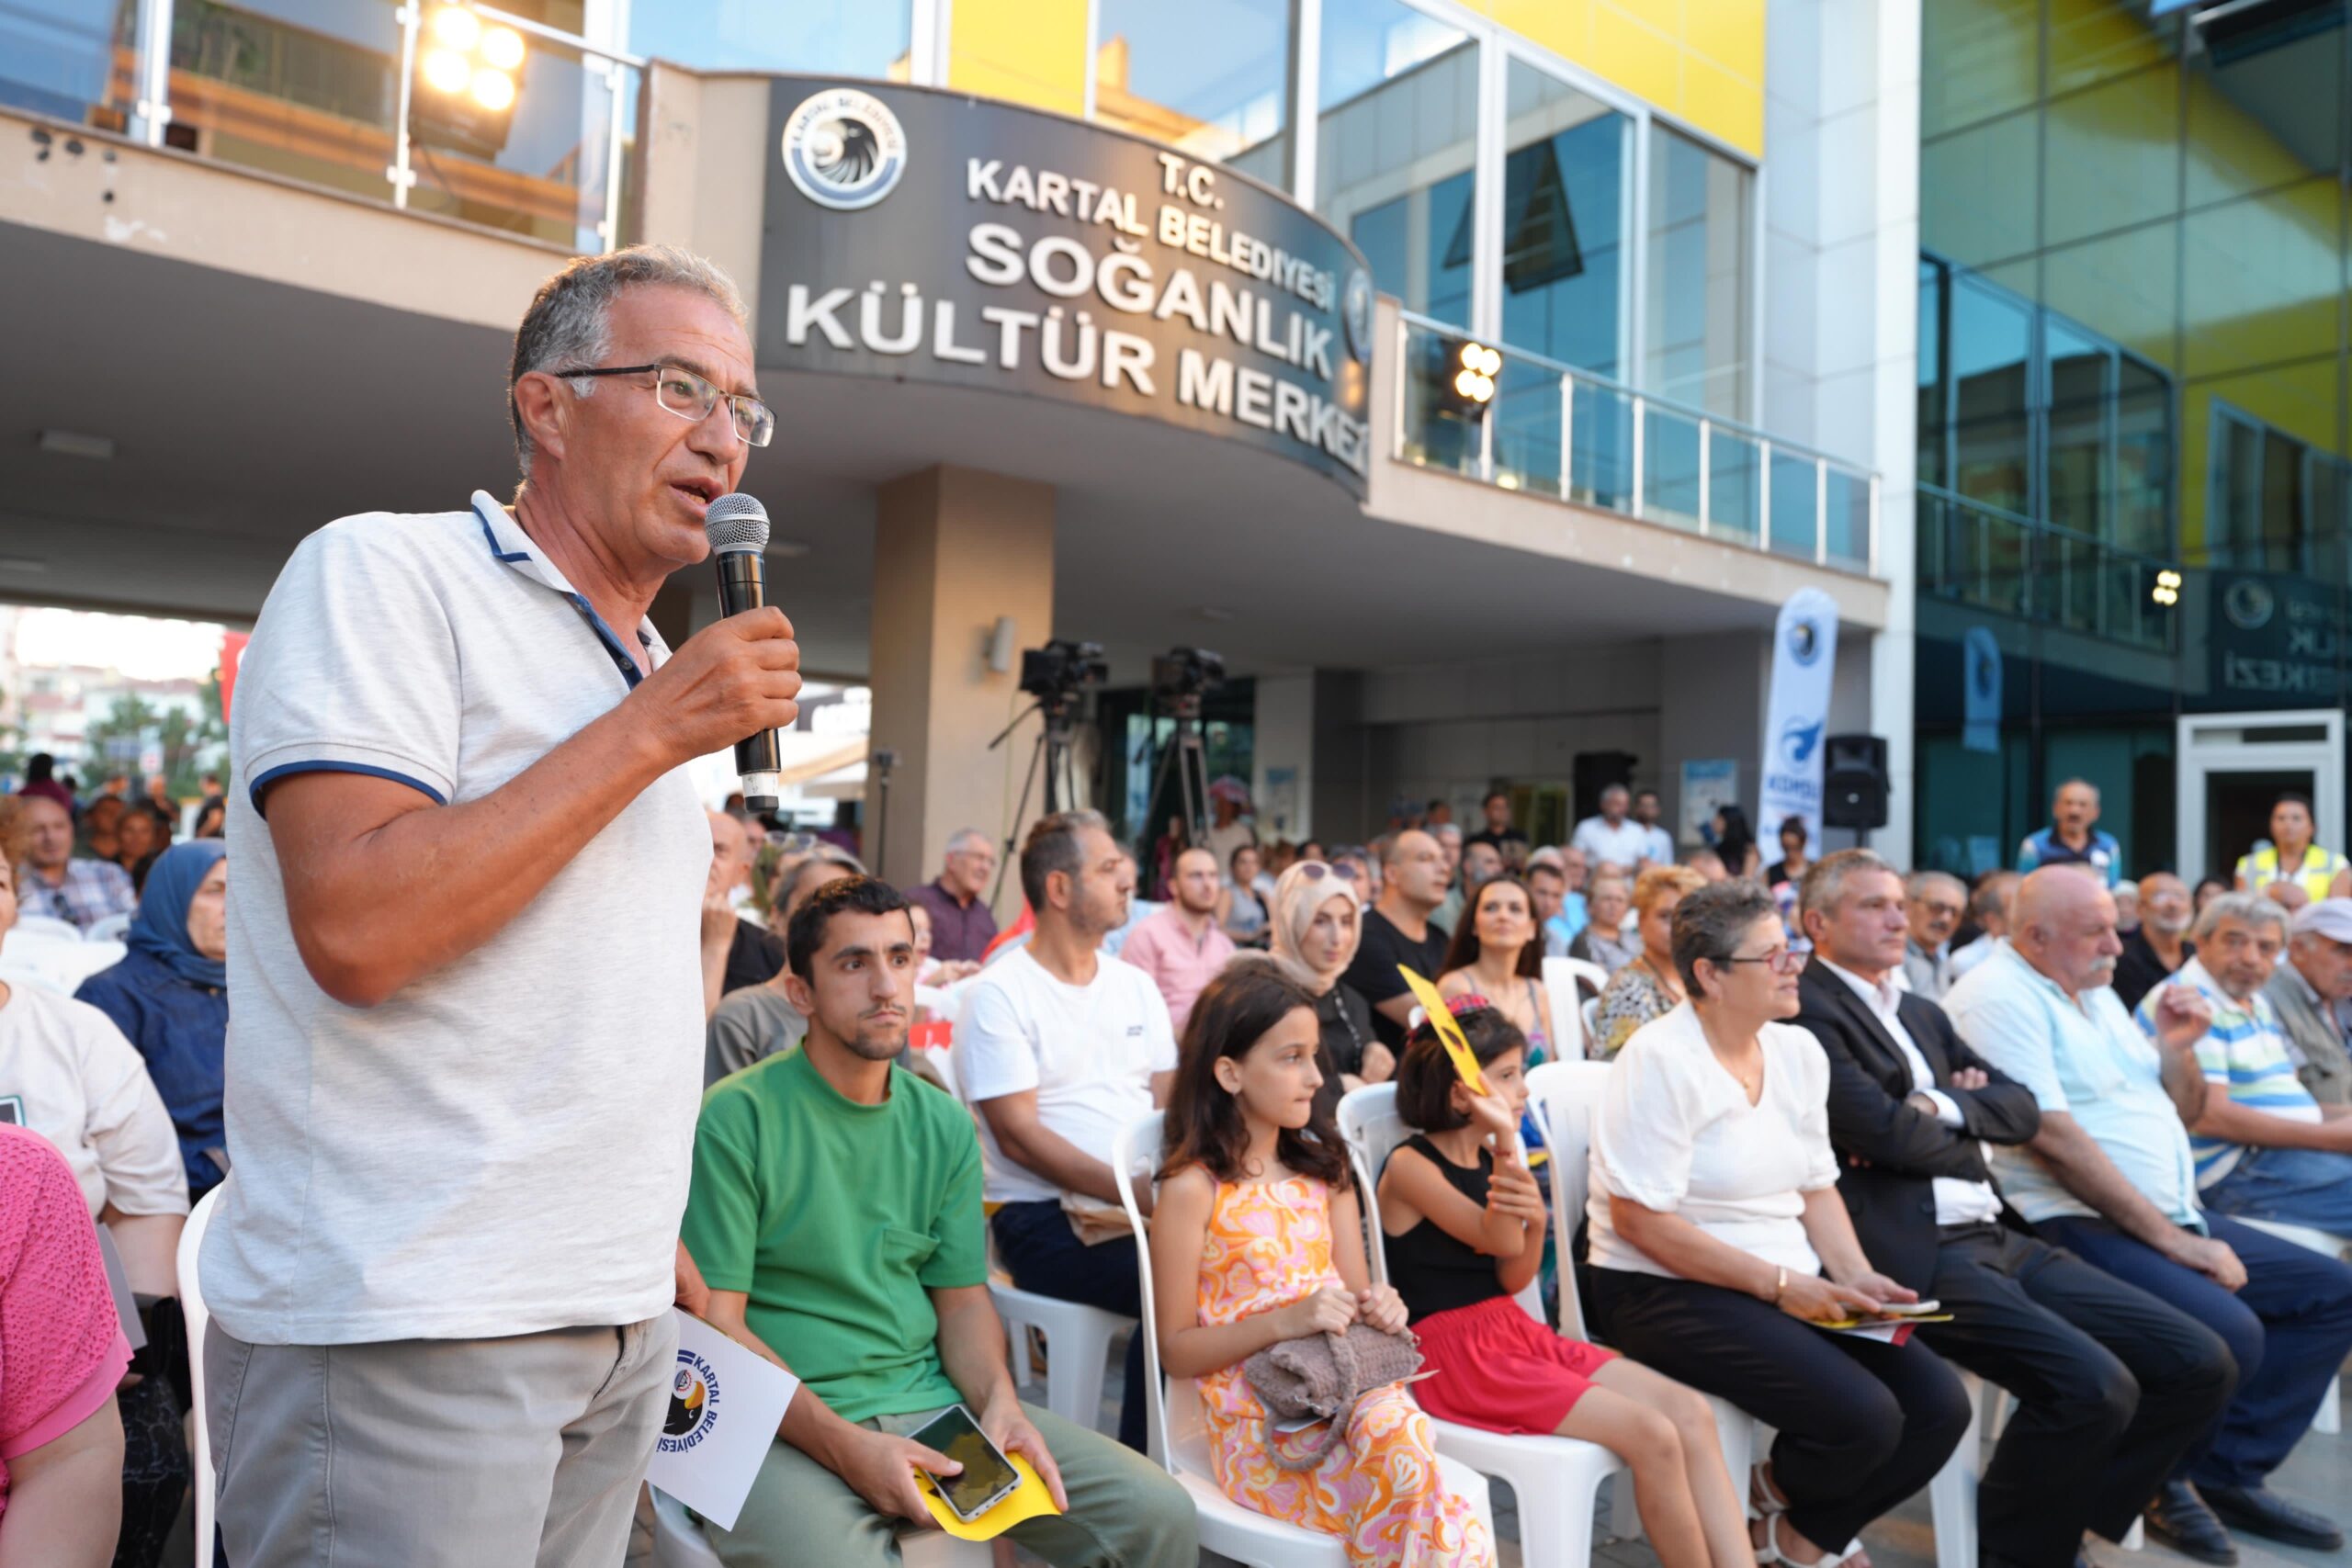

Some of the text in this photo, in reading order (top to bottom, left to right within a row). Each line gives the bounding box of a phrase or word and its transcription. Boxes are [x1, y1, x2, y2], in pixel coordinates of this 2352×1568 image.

[967, 157, 1149, 237] KARTAL
[1158, 151, 1224, 210] T.C.
[786, 279, 1158, 396] KÜLTÜR
[965, 221, 1333, 381] SOĞANLIK
[656, 1356, 720, 1453] KARTAL BELEDİYESİ
